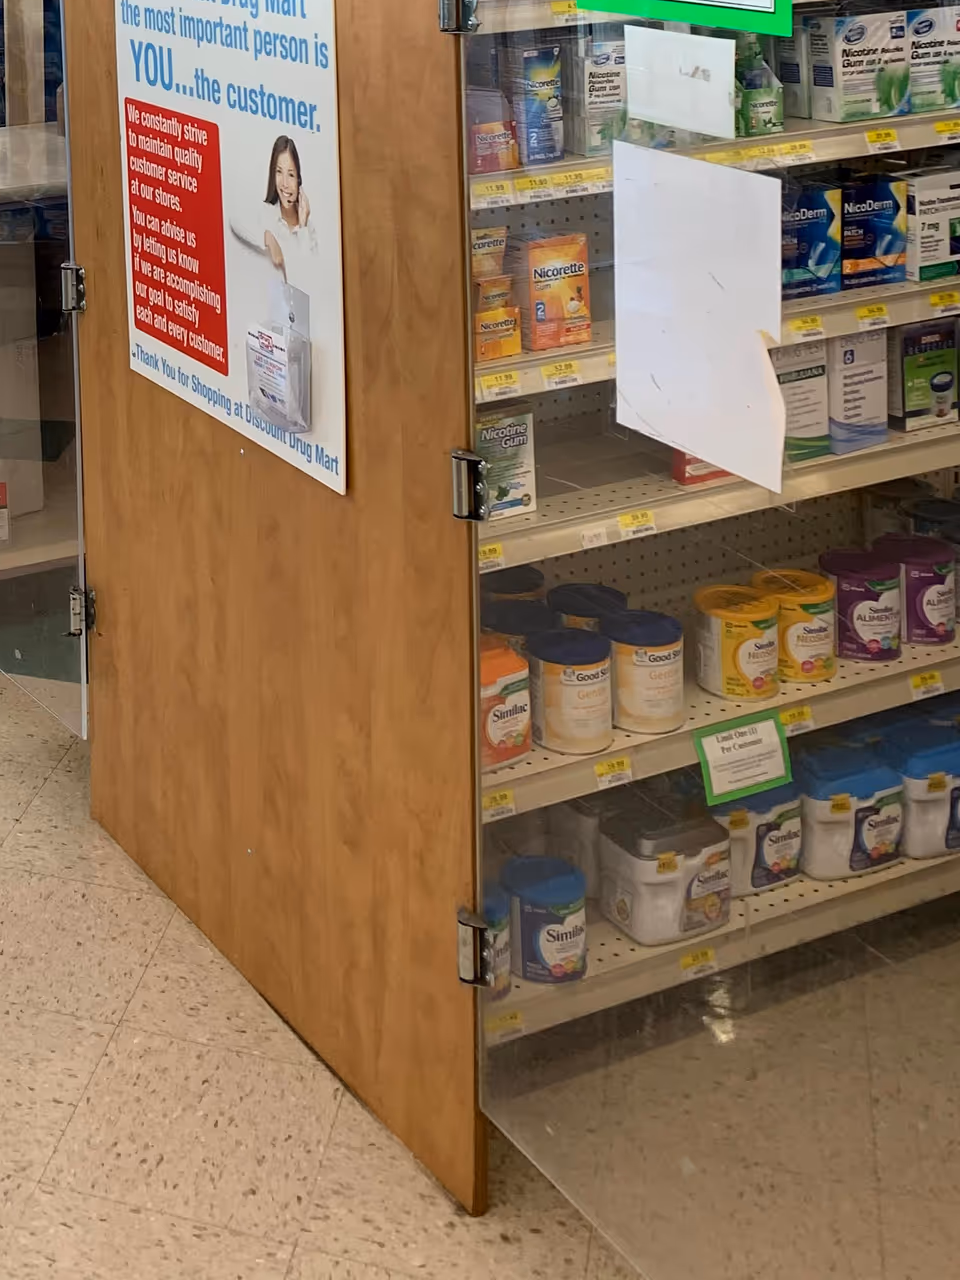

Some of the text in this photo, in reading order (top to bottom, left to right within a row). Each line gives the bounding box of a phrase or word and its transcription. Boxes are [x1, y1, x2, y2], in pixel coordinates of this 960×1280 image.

[144, 3, 177, 36] most
[179, 6, 250, 52] important
[252, 28, 310, 66] person
[314, 32, 330, 70] is
[911, 39, 945, 50] Nicotine
[841, 47, 879, 58] Nicotine
[911, 51, 931, 60] Gum
[842, 59, 864, 68] Gum
[588, 71, 621, 79] Nicotine
[527, 78, 560, 89] Nicorette
[588, 85, 607, 93] Gum
[226, 82, 322, 133] customer.
[749, 100, 778, 110] Nicorette
[127, 103, 208, 146] We constantly strive
[476, 131, 512, 143] Nicorette
[530, 133, 537, 144] 2
[128, 128, 203, 173] to maintain quality
[130, 156, 198, 193] customer service
[131, 178, 183, 212] at our stores.
[844, 199, 893, 214] NicoDerm
[132, 204, 196, 248] You can advise us
[844, 228, 864, 236] PATCH
[133, 228, 199, 274] by letting us know
[533, 262, 585, 281] Nicorette
[134, 253, 221, 314] if we are accomplishing
[534, 282, 552, 292] Gum
[135, 280, 199, 328] our goal to satisfy
[537, 304, 545, 316] 2
[480, 318, 517, 331] Nicorette
[136, 305, 225, 363] each and every customer.
[844, 351, 853, 364] 6
[135, 343, 339, 476] Thank You for Shopping at Discount Drug Mart
[480, 422, 528, 441] Nicotine
[501, 435, 528, 449] Gum
[648, 654, 671, 663] Good
[576, 671, 600, 683] Good
[492, 703, 528, 723] Similac
[716, 731, 748, 743] Limit One
[720, 738, 763, 754] Per Customer
[867, 814, 900, 832] Similac
[768, 829, 800, 847] Similac
[696, 869, 729, 884] Similac
[546, 924, 586, 943] Similac
